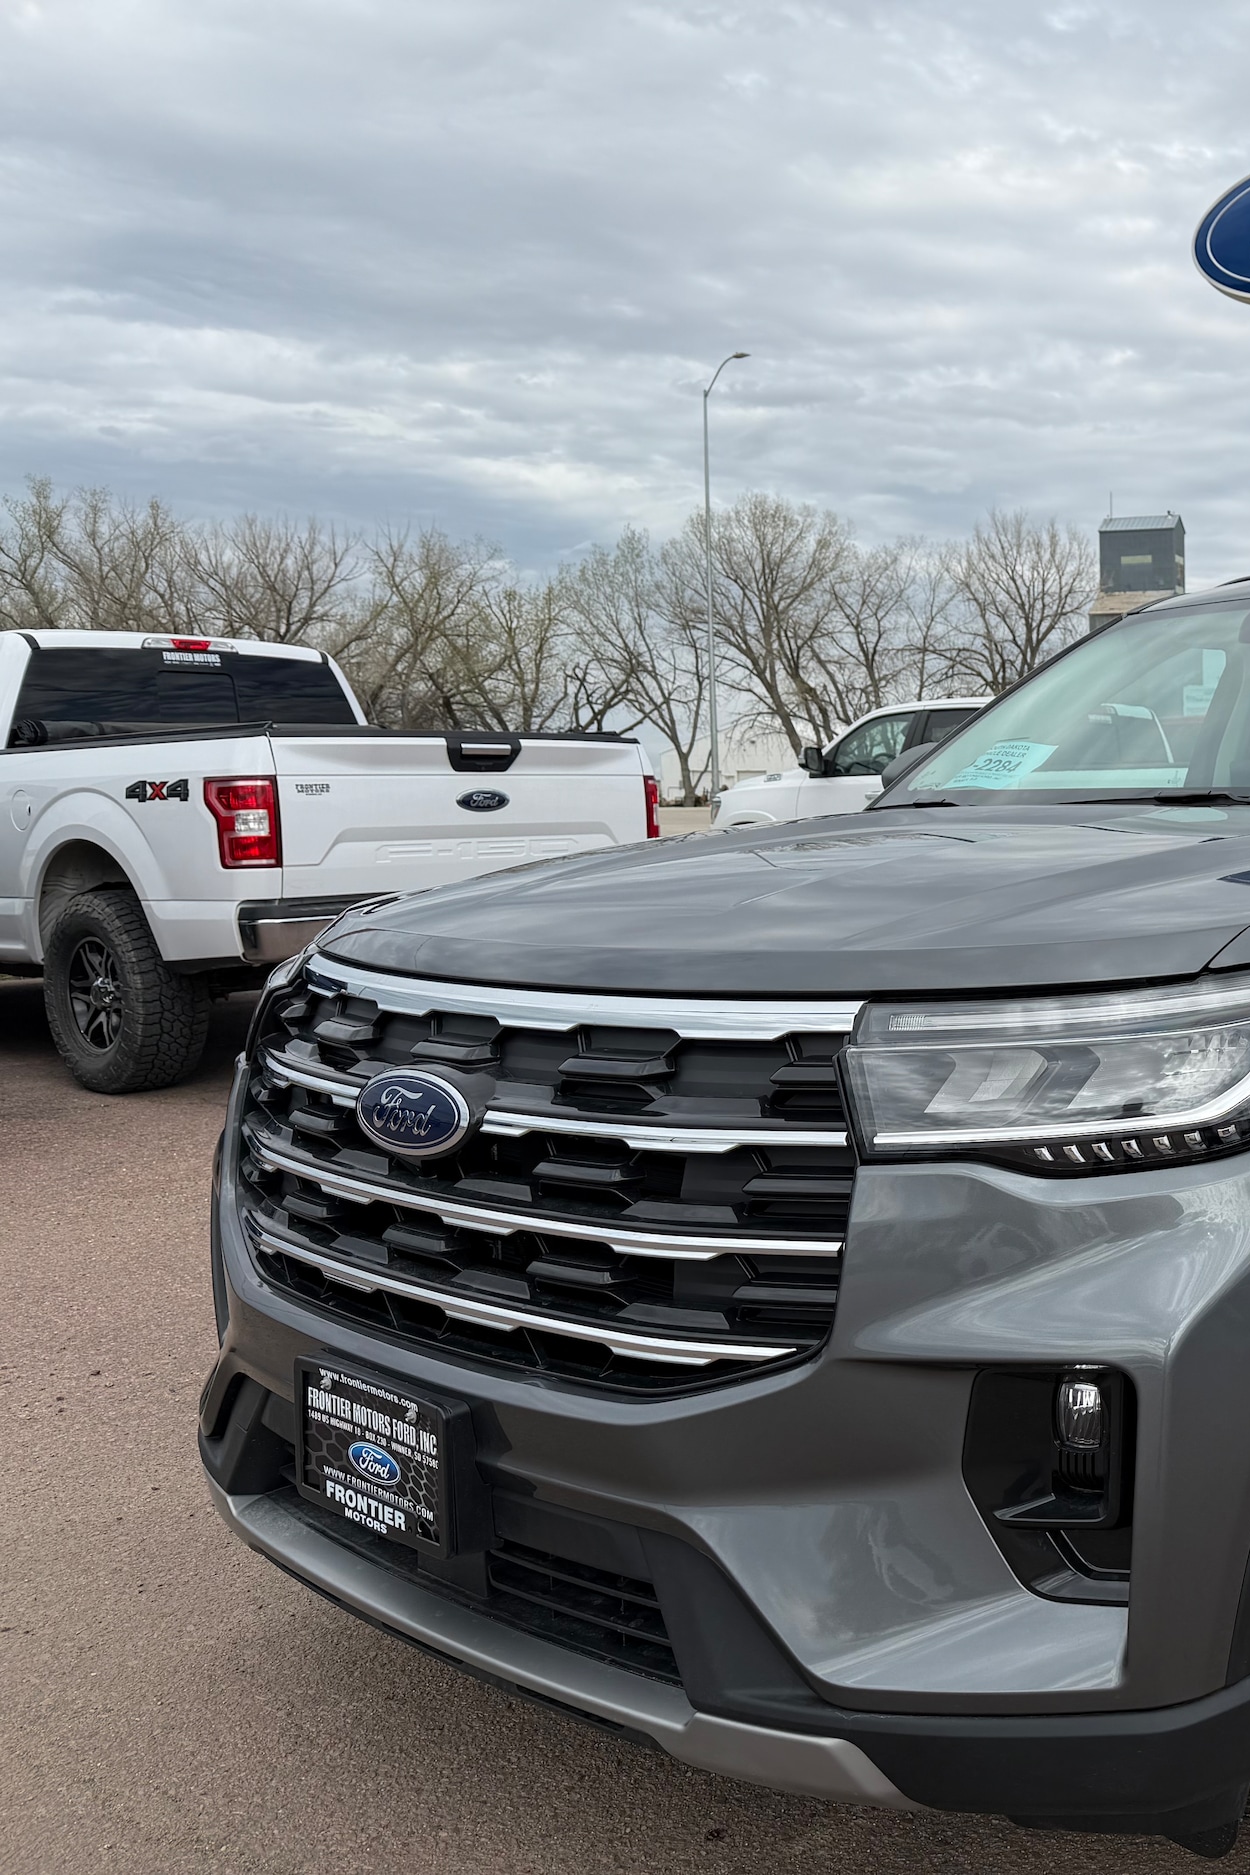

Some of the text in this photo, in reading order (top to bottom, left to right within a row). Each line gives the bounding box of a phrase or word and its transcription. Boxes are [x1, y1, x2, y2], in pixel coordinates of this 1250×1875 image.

[162, 651, 221, 663] FRONTIER MOTORS
[470, 793, 499, 807] Ford
[375, 837, 580, 864] F-150
[372, 1085, 436, 1137] Ford
[307, 1386, 351, 1418] FRONTIER
[352, 1402, 391, 1437] MOTORS
[358, 1447, 391, 1480] Ford
[323, 1464, 434, 1522] WWW.FRONTIERMOTORS.COM
[325, 1479, 407, 1532] FRONTIER
[344, 1506, 388, 1535] MOTORS
